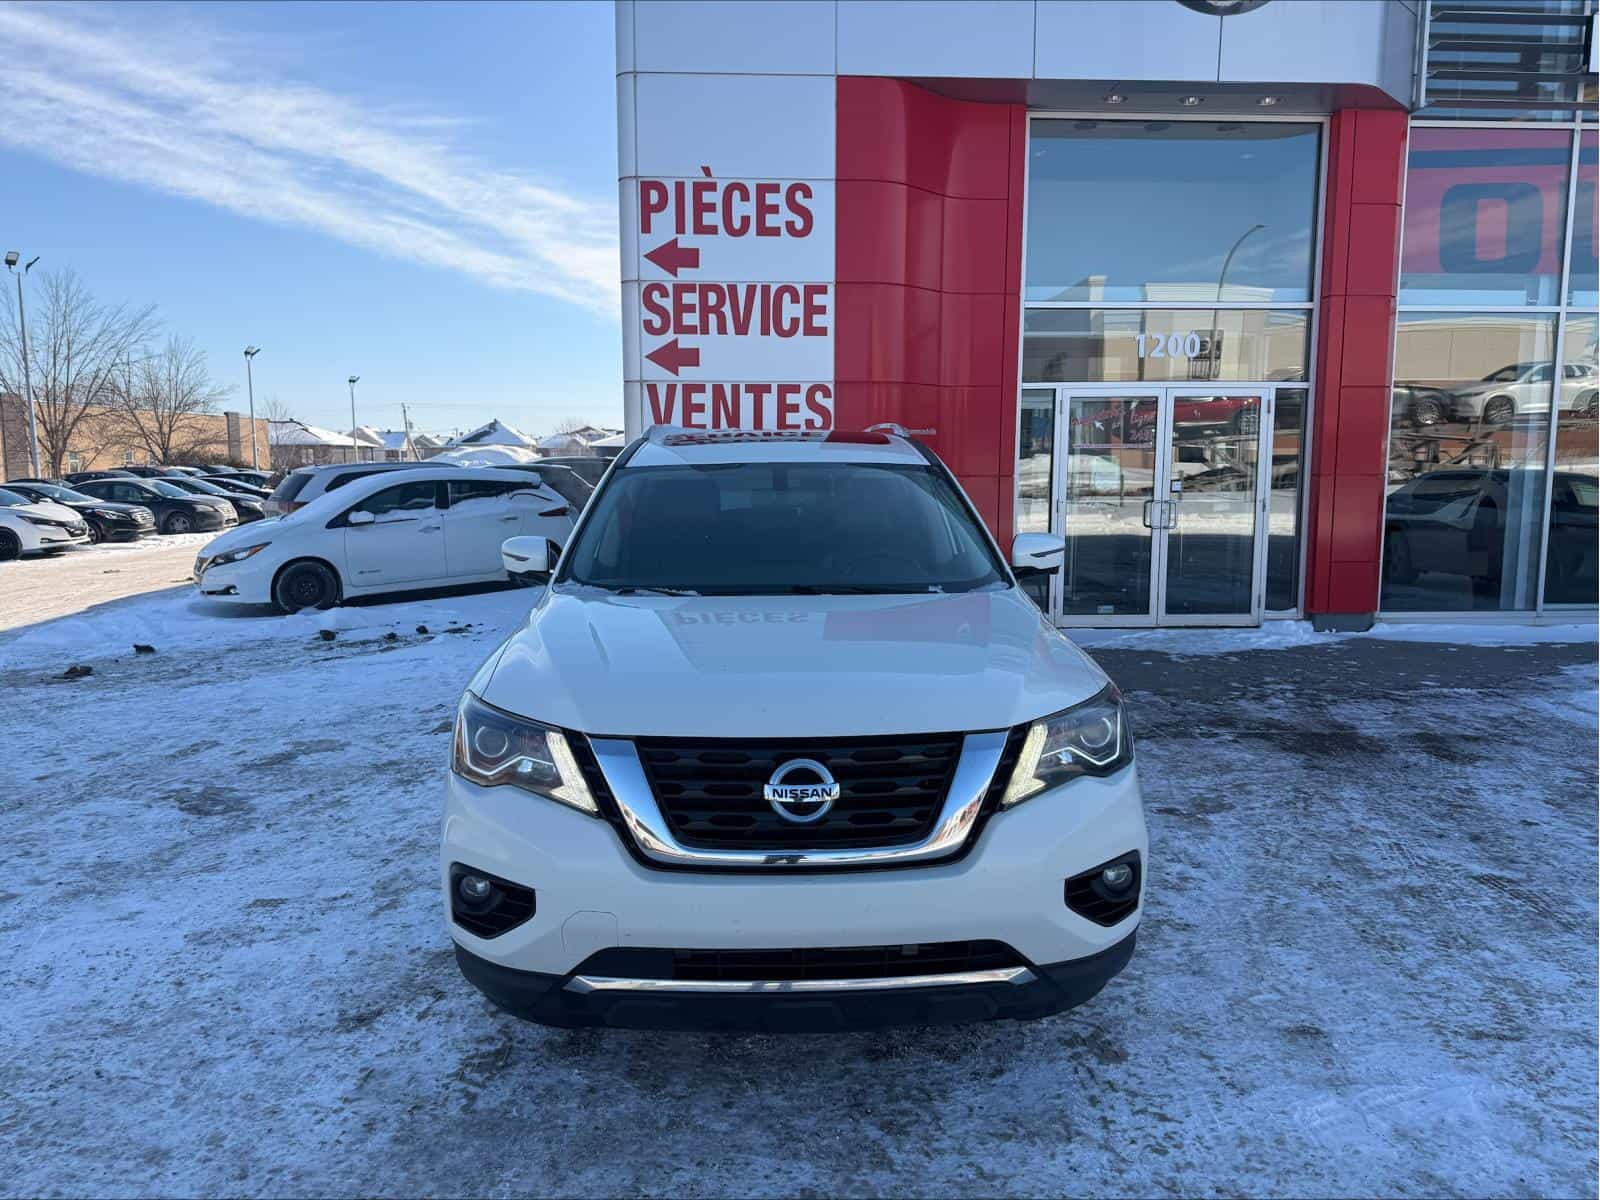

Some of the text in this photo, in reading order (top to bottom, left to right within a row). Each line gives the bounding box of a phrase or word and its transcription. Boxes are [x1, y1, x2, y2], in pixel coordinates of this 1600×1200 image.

[640, 165, 813, 238] PIÈCES
[642, 283, 828, 338] SERVICE
[1136, 333, 1200, 358] 1200
[646, 384, 832, 430] VENTES
[772, 787, 832, 799] NISSAN
